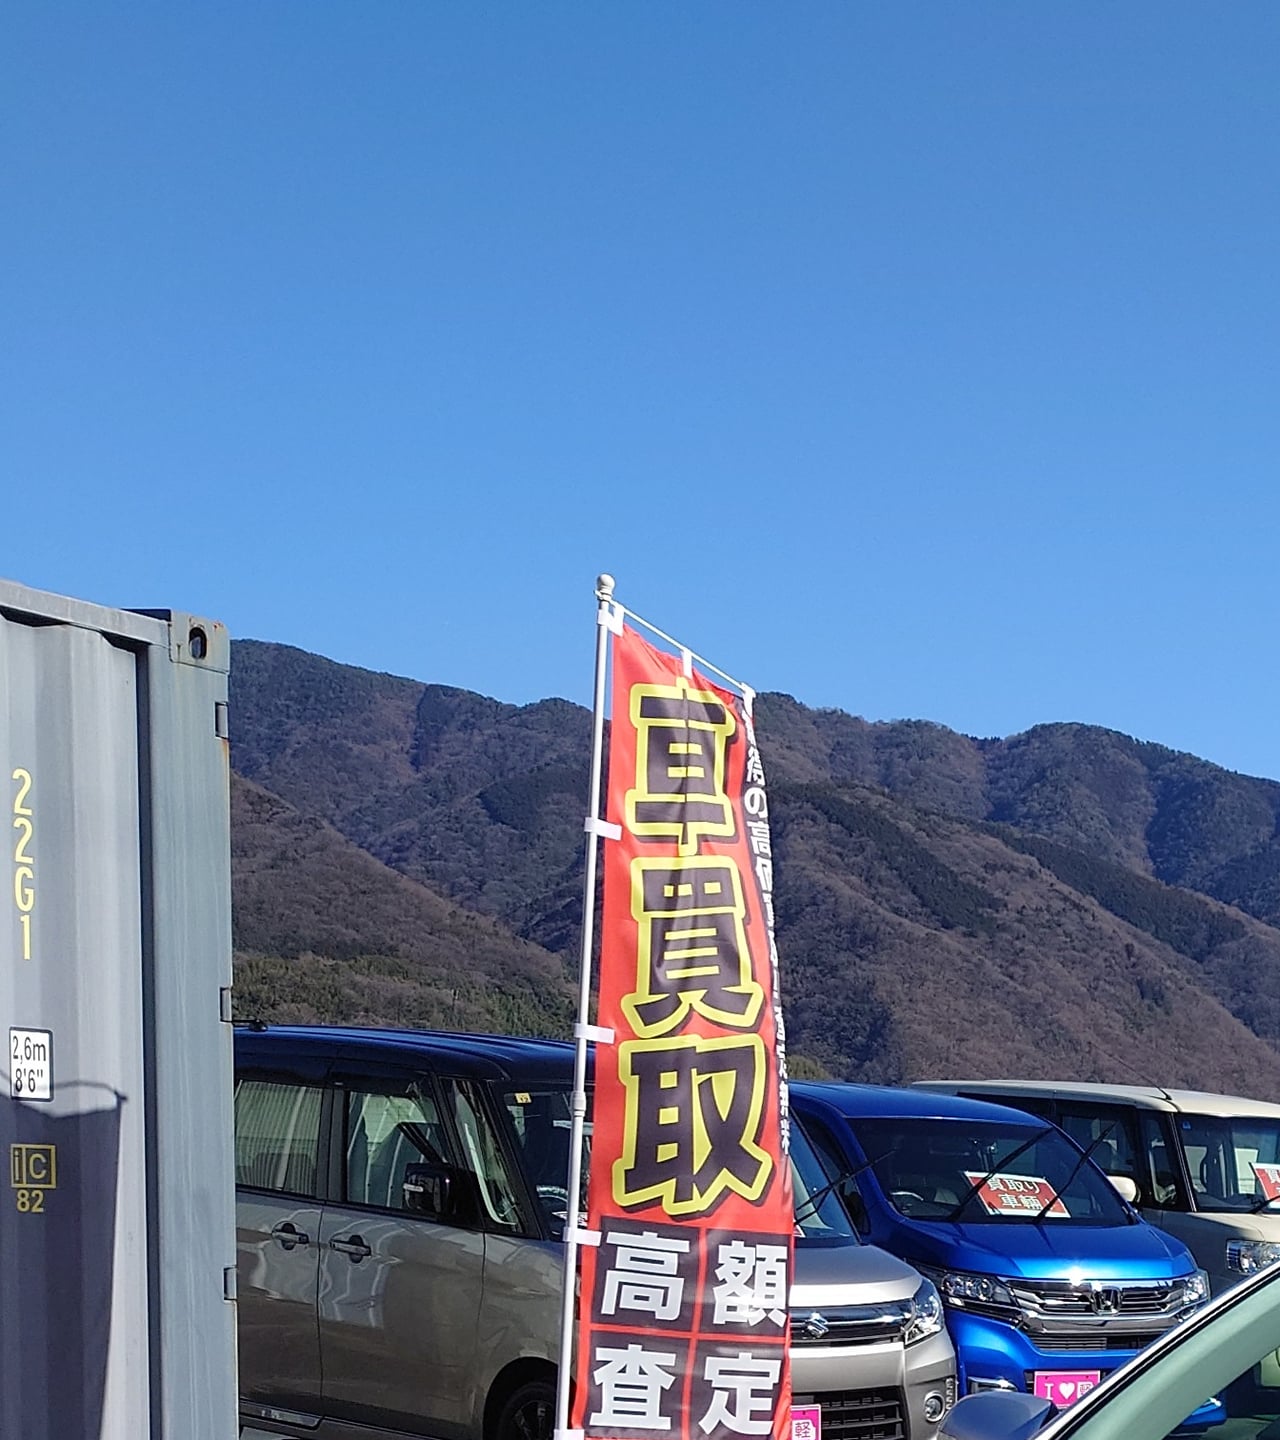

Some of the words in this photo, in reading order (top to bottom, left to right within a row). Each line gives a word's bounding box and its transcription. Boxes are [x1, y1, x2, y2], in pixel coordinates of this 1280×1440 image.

[12, 768, 35, 961] 22G1
[612, 676, 773, 1216] 車買取
[12, 1035, 47, 1065] 2,6m
[986, 1176, 1040, 1194] 買取り
[16, 1189, 45, 1214] 82
[794, 1421, 811, 1439] 軽
